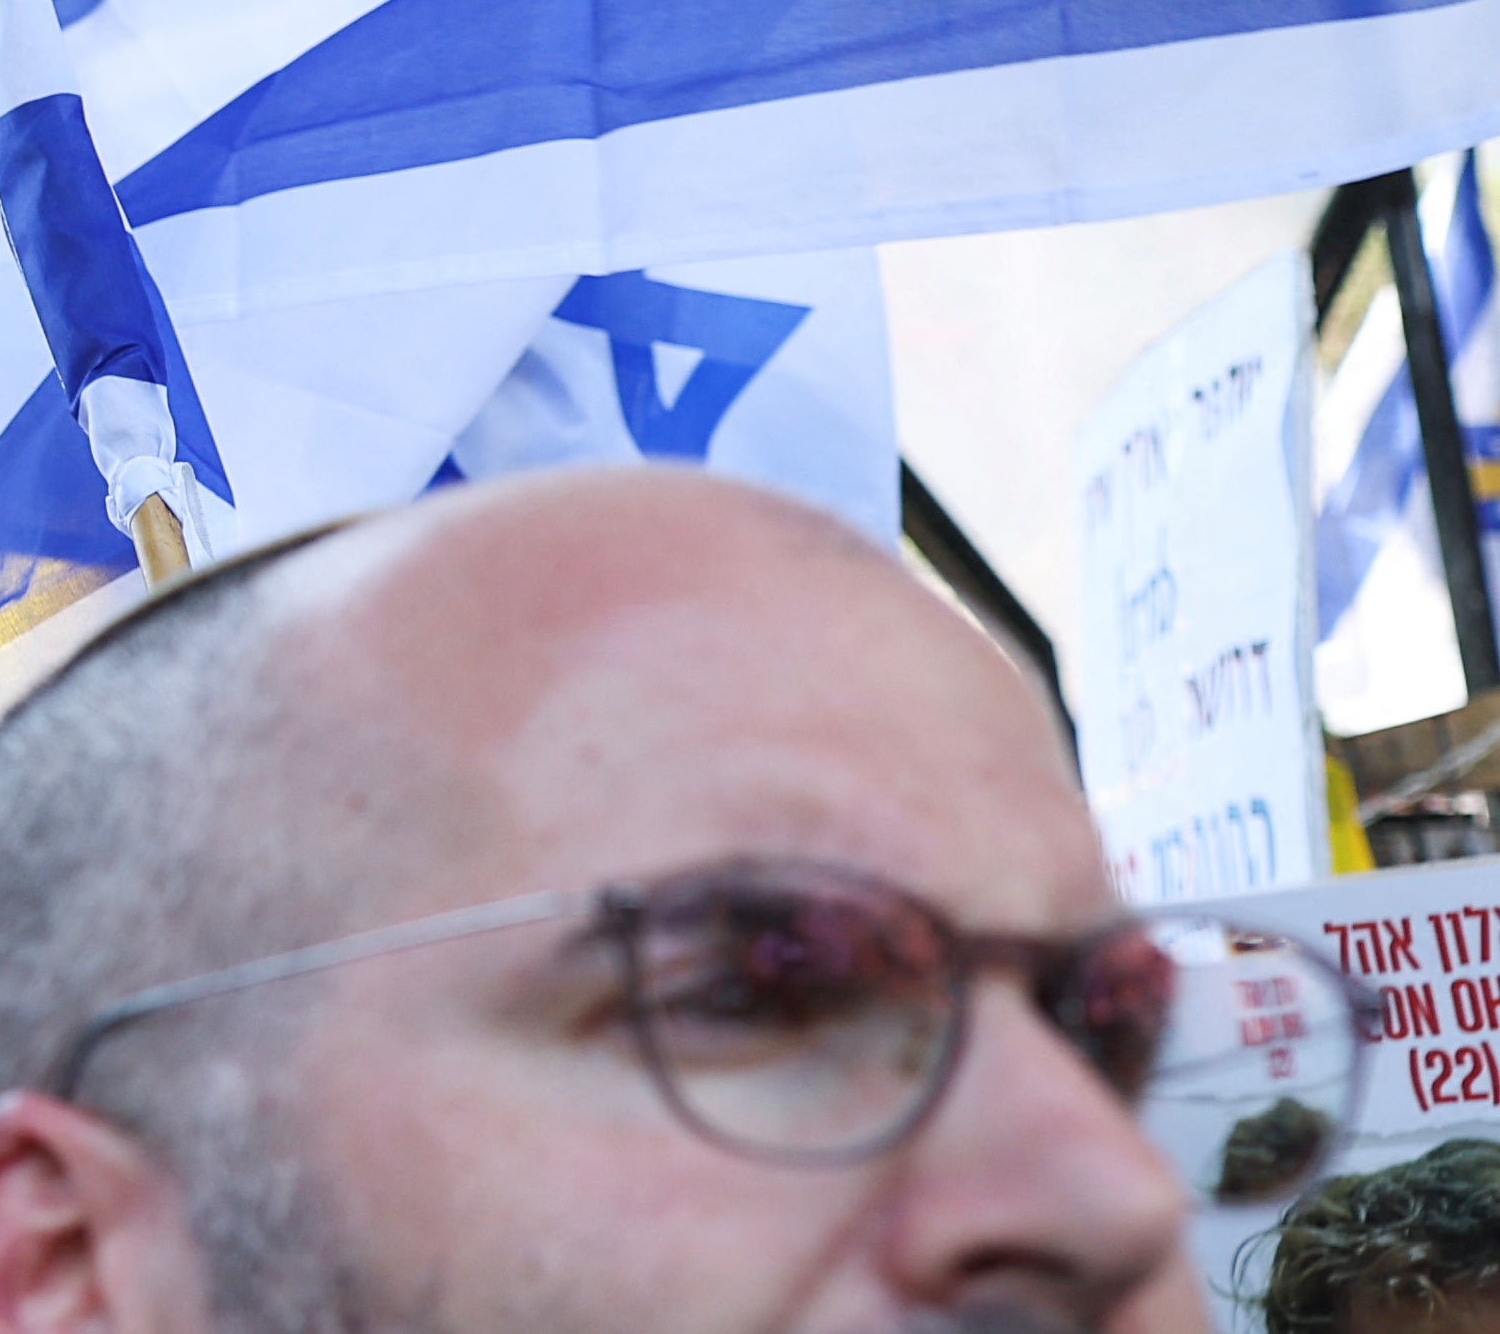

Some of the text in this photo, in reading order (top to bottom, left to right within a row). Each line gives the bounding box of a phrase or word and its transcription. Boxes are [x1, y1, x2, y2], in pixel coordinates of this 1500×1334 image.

[1324, 905, 1500, 975] לון אהל
[1450, 975, 1500, 1034] OH
